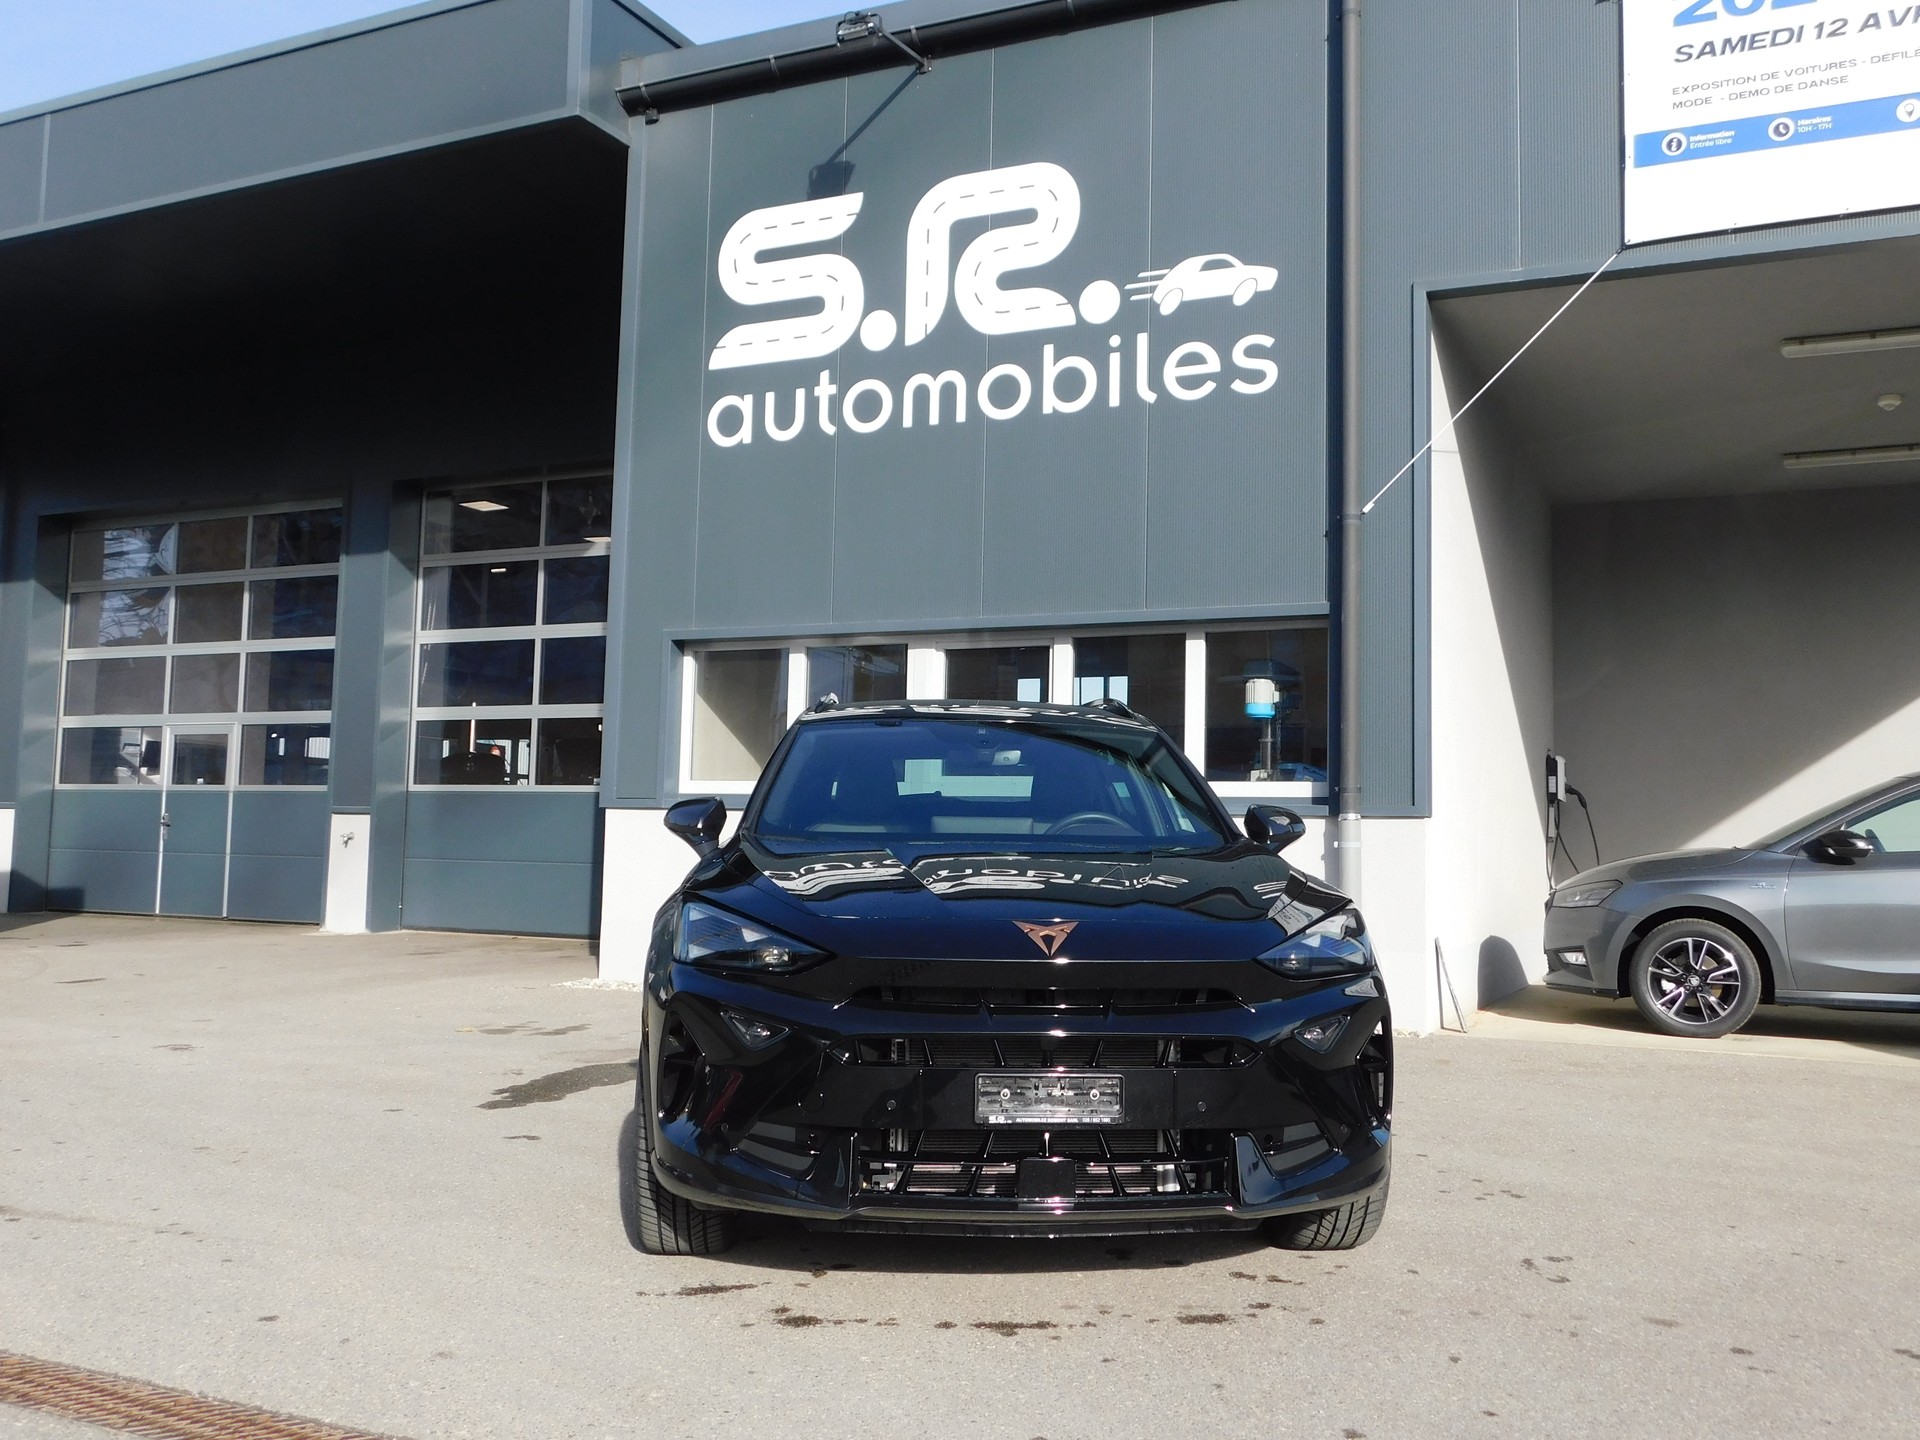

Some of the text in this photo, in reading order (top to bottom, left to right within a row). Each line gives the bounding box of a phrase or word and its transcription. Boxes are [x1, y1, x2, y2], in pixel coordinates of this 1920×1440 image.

[1674, 24, 1805, 63] SAMEDI
[1813, 17, 1849, 40] 12
[1672, 75, 1756, 96] EXPOSITION
[1760, 71, 1780, 82] DE
[1784, 58, 1857, 78] VOITURES
[1672, 96, 1713, 110] MODE
[1728, 87, 1770, 102] DEMO
[1774, 83, 1794, 94] DE
[1798, 75, 1849, 91] DANSE
[1690, 130, 1735, 142] Information
[1798, 116, 1832, 126] Horaires
[1690, 139, 1714, 149] Entrée
[709, 162, 1120, 370] S.R.
[707, 332, 1278, 447] automobiles
